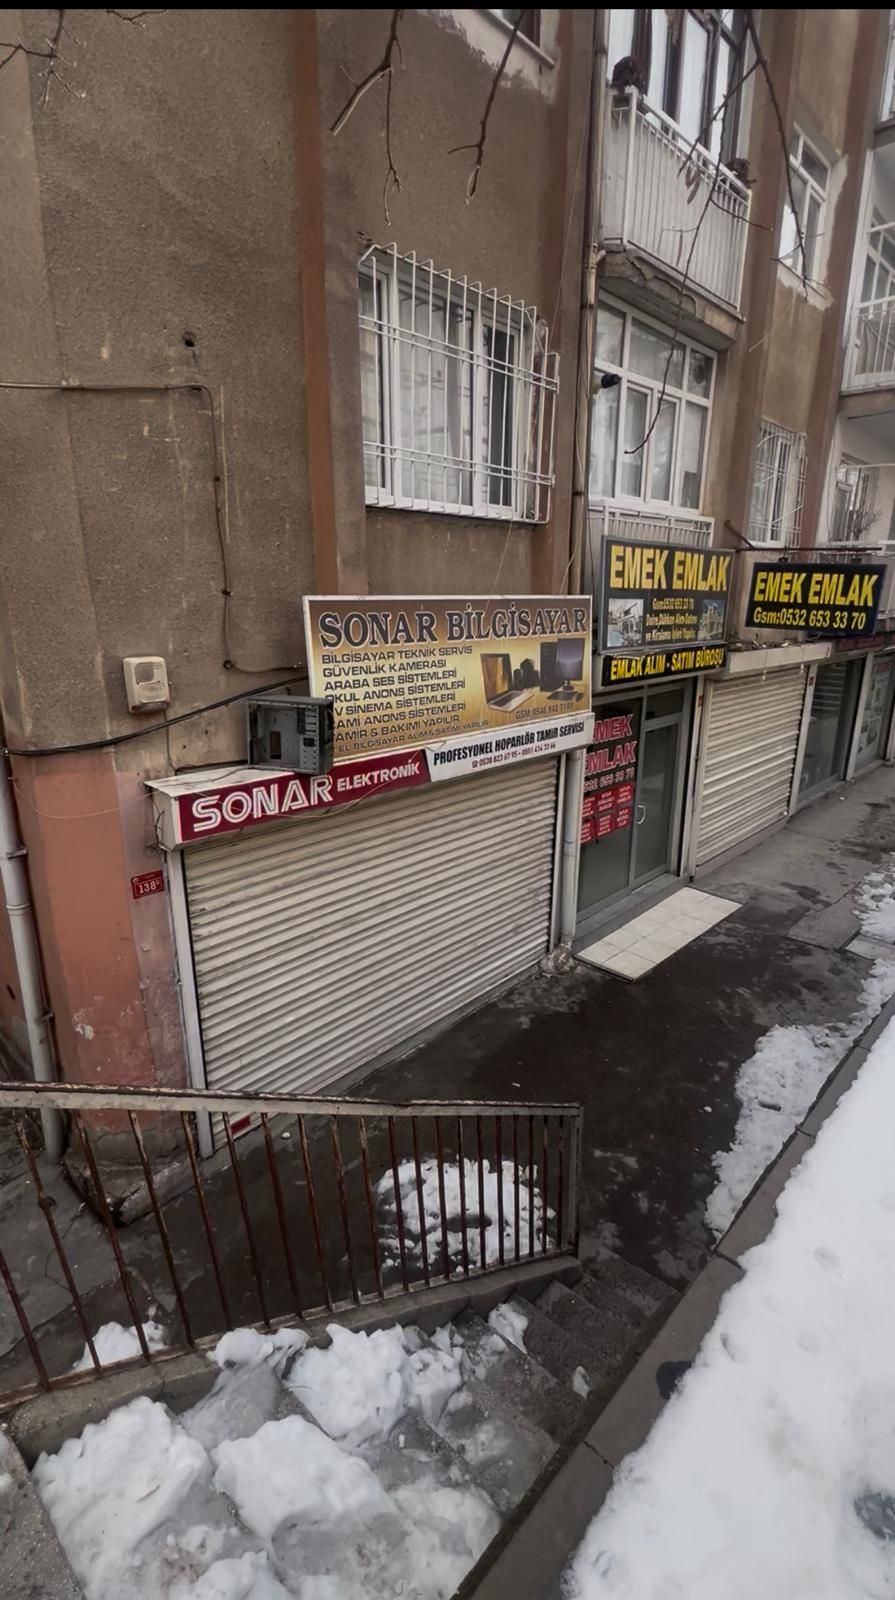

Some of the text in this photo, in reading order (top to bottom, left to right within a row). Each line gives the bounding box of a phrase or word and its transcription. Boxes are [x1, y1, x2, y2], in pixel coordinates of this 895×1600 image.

[610, 544, 731, 592] EMEK EMLAK
[753, 571, 879, 607] EMEK EMLAK
[319, 601, 588, 649] SONAR BİLGİSAYAR
[753, 607, 866, 630] Gsm:0532 653 33 70
[322, 645, 472, 664] BİLGİSAYAR TEKNİK SERVİS
[323, 659, 446, 677] GÜVENLİK KAMERASI
[610, 655, 644, 680] EMLAK
[644, 654, 666, 675] ALIM
[671, 651, 695, 671] SATIM
[324, 667, 457, 691] ARABA SES SİSTEMLERİ
[363, 688, 405, 700] ANONS
[407, 679, 465, 695] SİSTEMLERİ
[334, 702, 466, 729] AMİ ANONS SİSTEMLERİ
[346, 702, 392, 715] SİNEMA
[396, 692, 456, 708] SİSTEMLERİ
[335, 715, 460, 742] AMİR & BAKIMI YAPILIR
[433, 741, 493, 766] PROFESYONEL
[494, 730, 535, 751] HOPARLÖR
[192, 760, 421, 832] SONAR ELEKTRONİK
